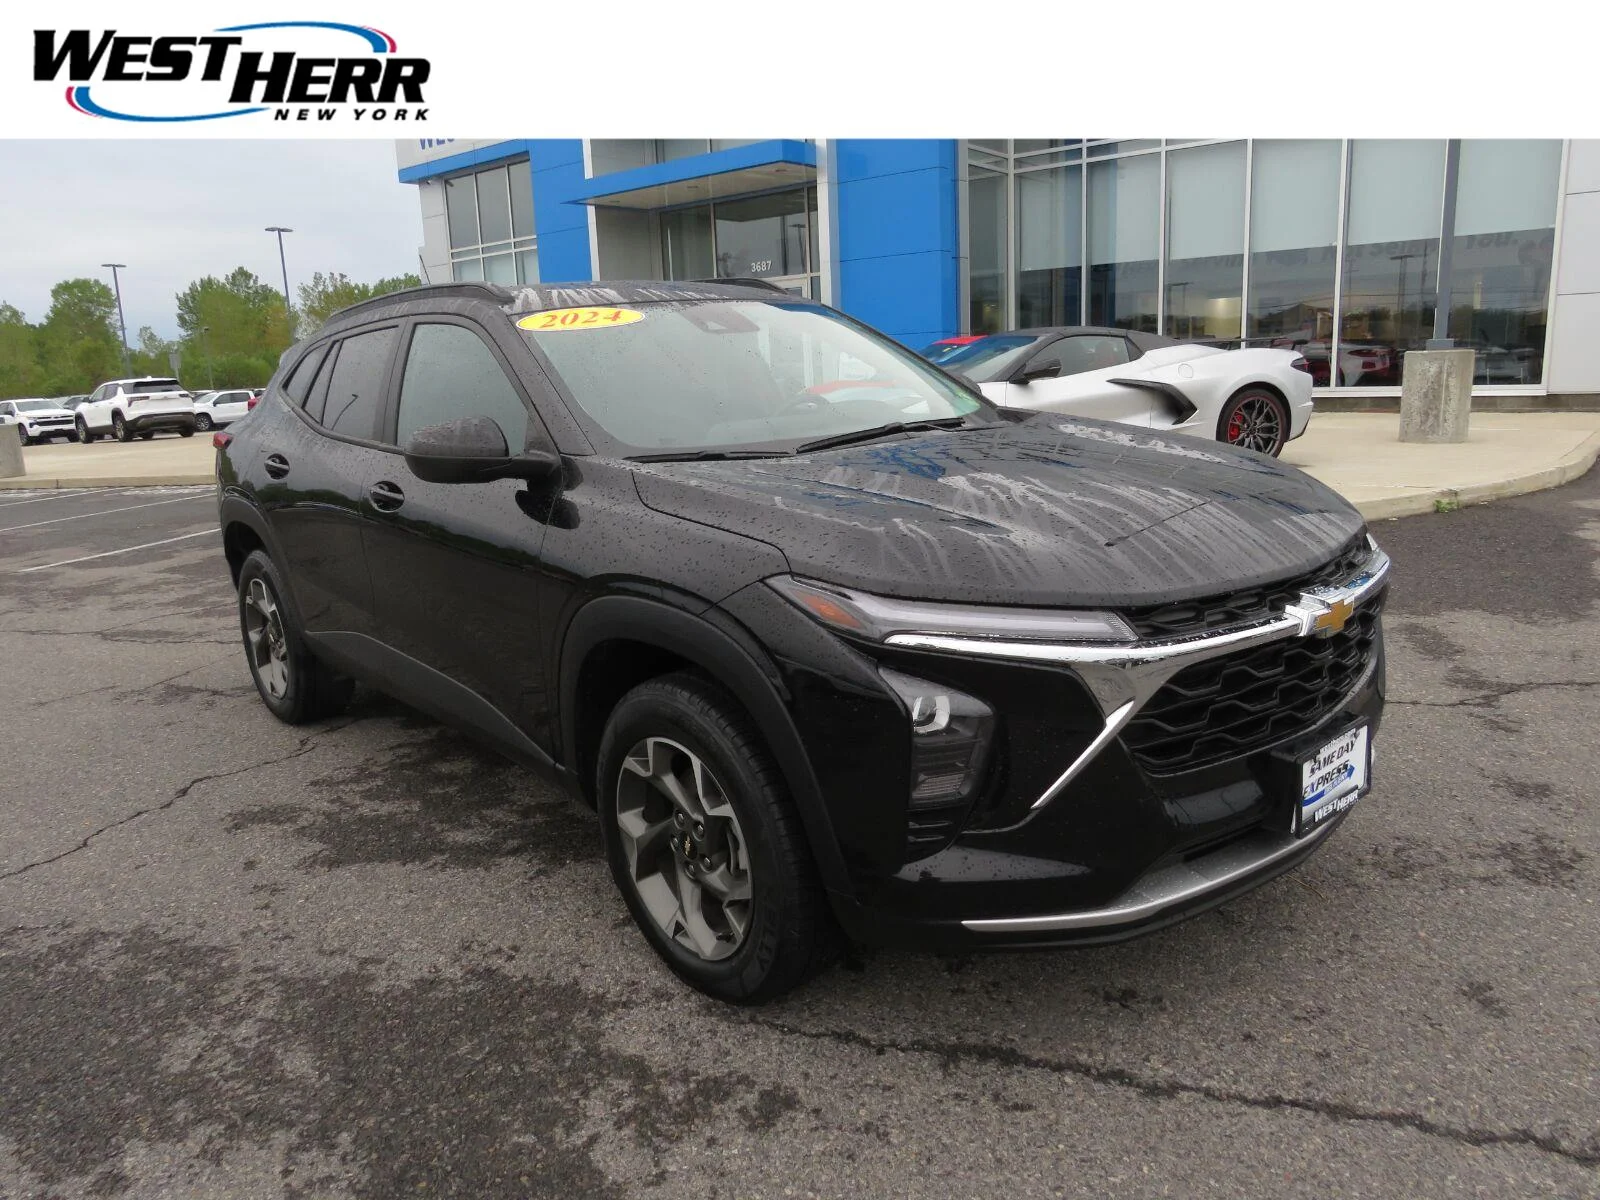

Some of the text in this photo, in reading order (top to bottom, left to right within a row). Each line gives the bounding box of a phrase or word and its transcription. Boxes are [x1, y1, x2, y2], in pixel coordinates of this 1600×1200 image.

[751, 260, 771, 272] 3687
[539, 310, 622, 329] 2024
[1309, 750, 1337, 778] SAME
[1336, 738, 1357, 760] DAY
[1303, 759, 1350, 798] EXPRESS
